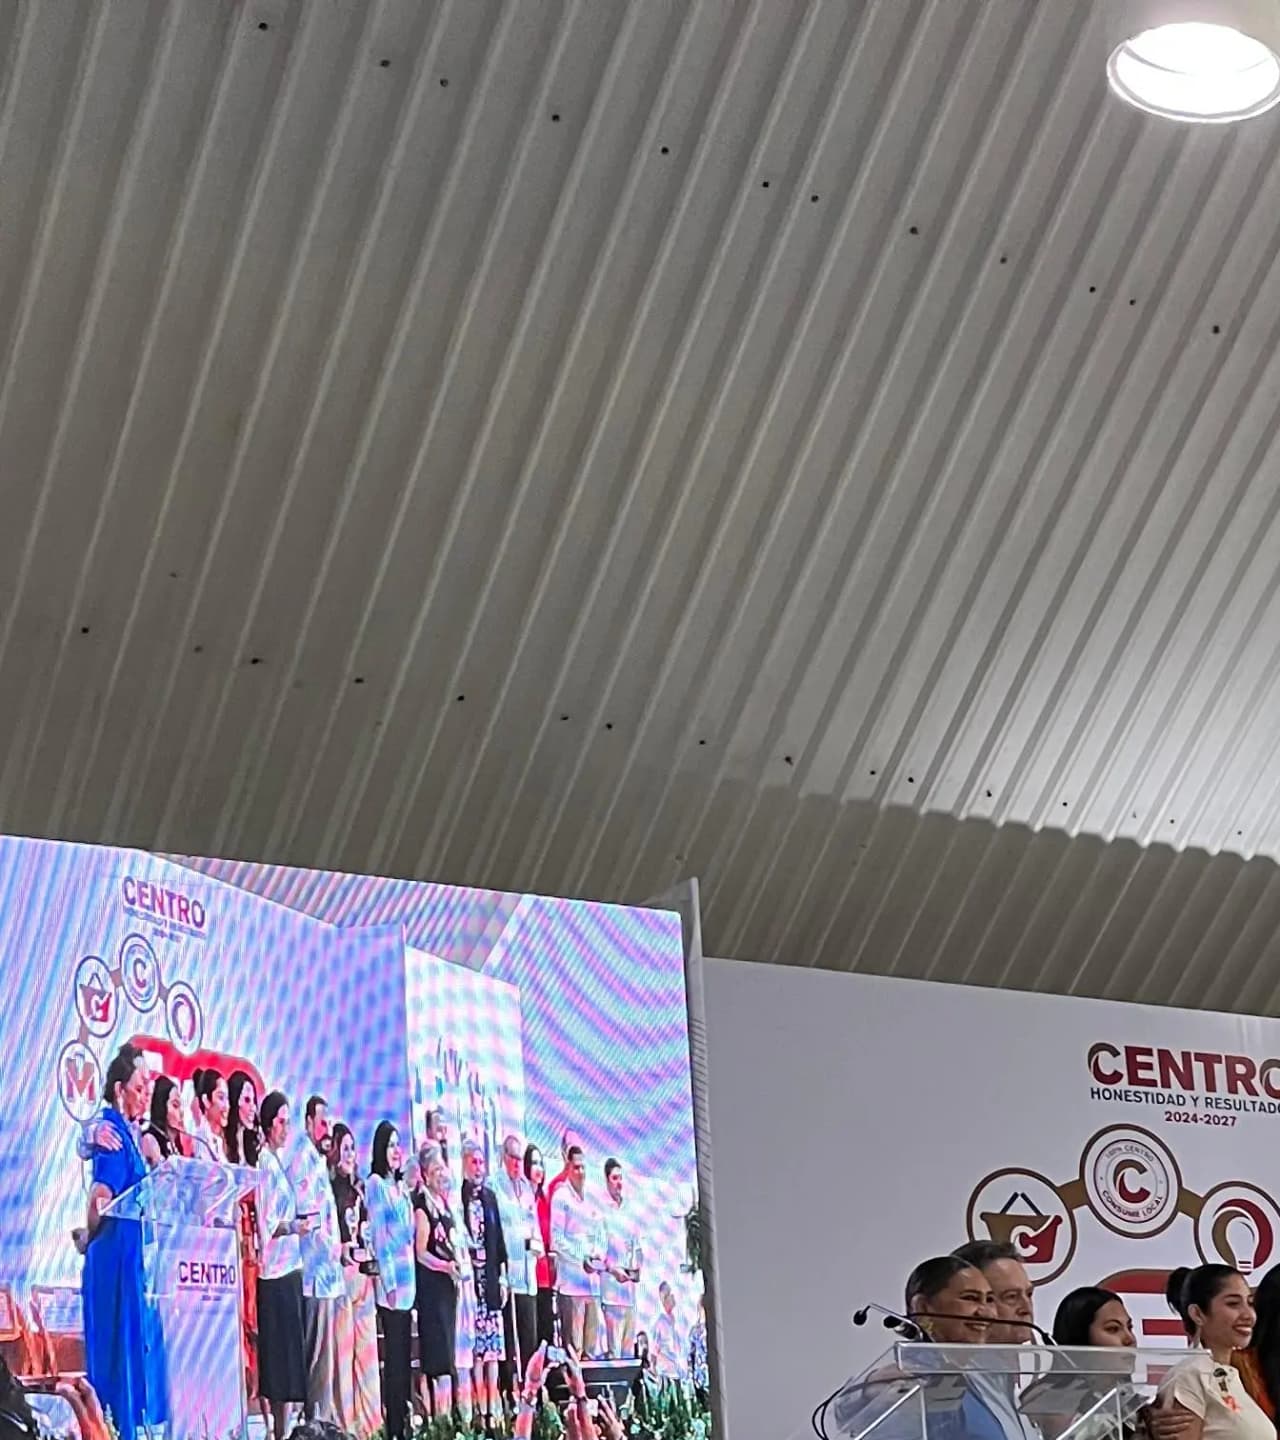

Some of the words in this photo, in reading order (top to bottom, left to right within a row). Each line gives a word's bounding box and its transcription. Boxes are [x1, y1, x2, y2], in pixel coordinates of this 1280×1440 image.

[123, 876, 206, 929] CENTRO
[1090, 1087, 1187, 1107] HONESTIDAD
[1190, 1096, 1200, 1108] Y
[1164, 1111, 1237, 1127] 2024-2027
[1142, 1195, 1163, 1217] LOCAL
[178, 1261, 236, 1285] CENTRO
